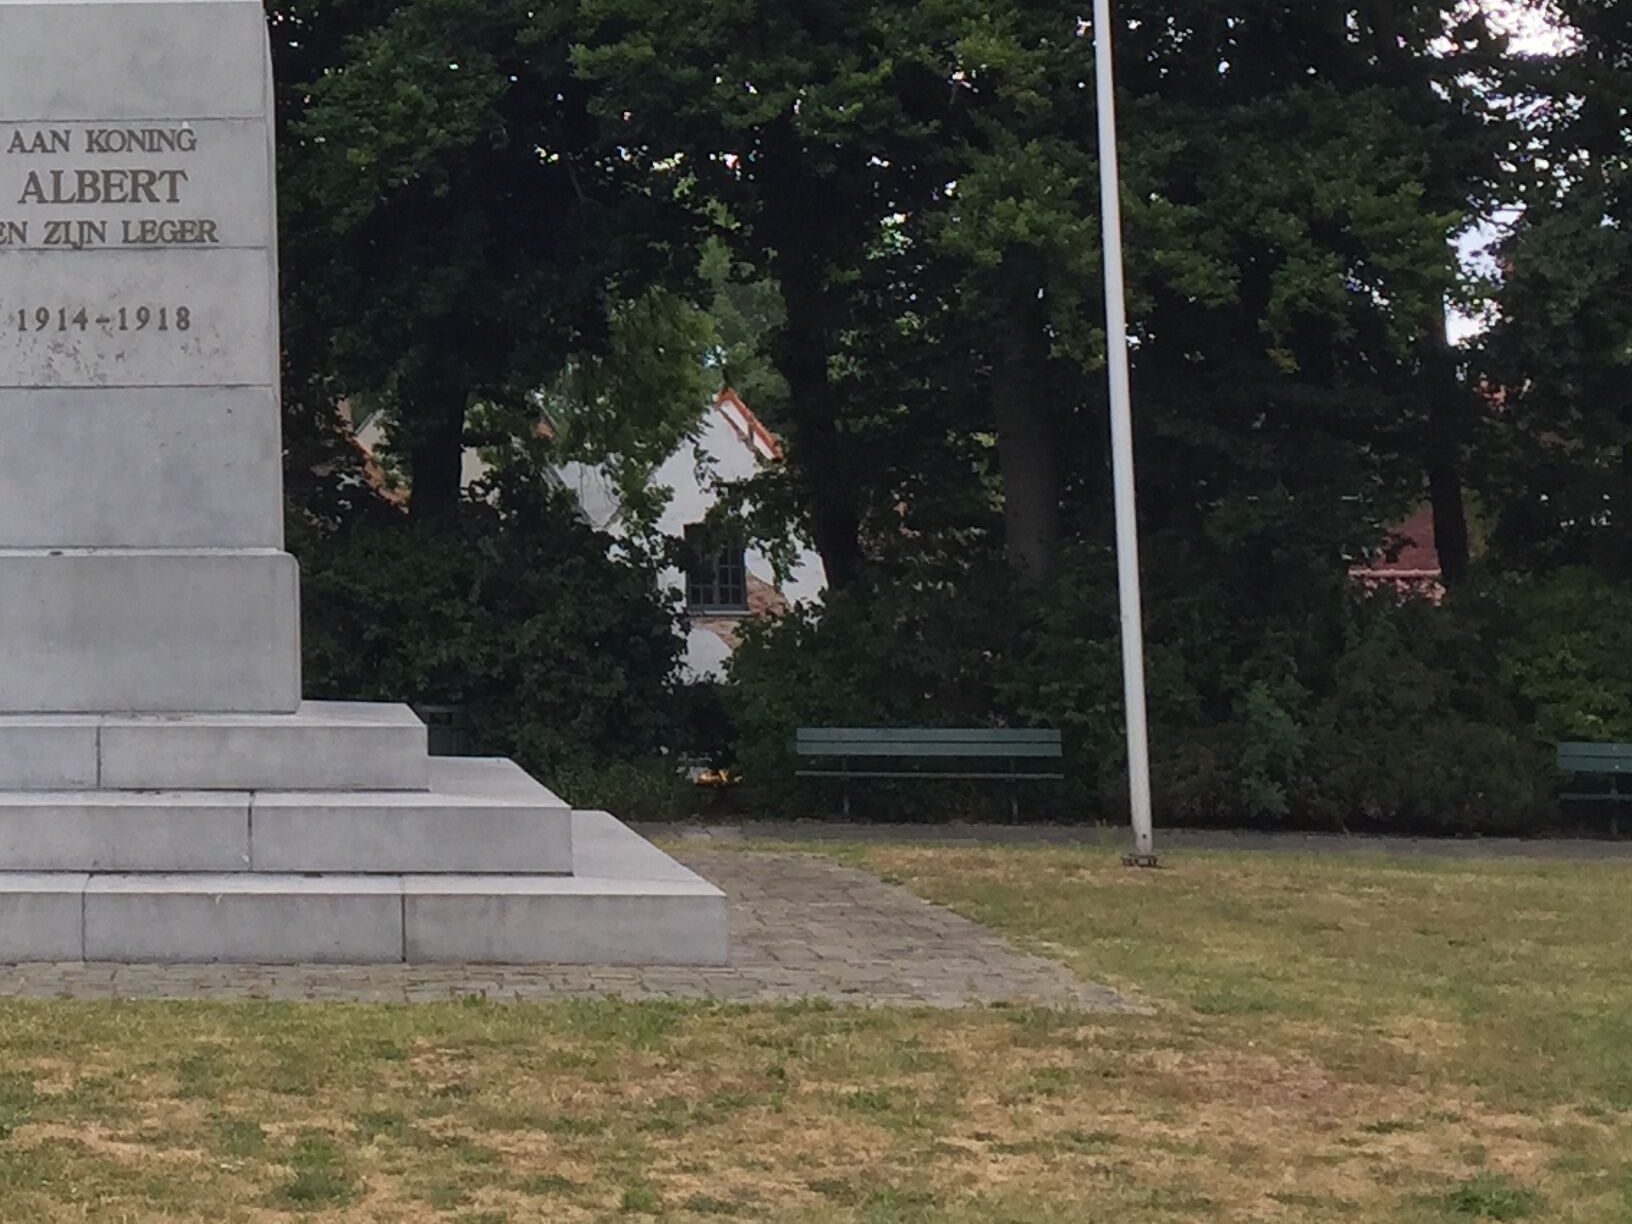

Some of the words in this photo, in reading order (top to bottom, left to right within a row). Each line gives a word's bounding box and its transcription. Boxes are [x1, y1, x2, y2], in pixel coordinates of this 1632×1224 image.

[6, 129, 71, 154] AAN
[85, 128, 198, 153] KONING
[17, 169, 189, 205] ALBERT
[43, 220, 108, 250] ZIJN
[122, 219, 219, 244] LEGER
[16, 306, 192, 332] 1914-1918
